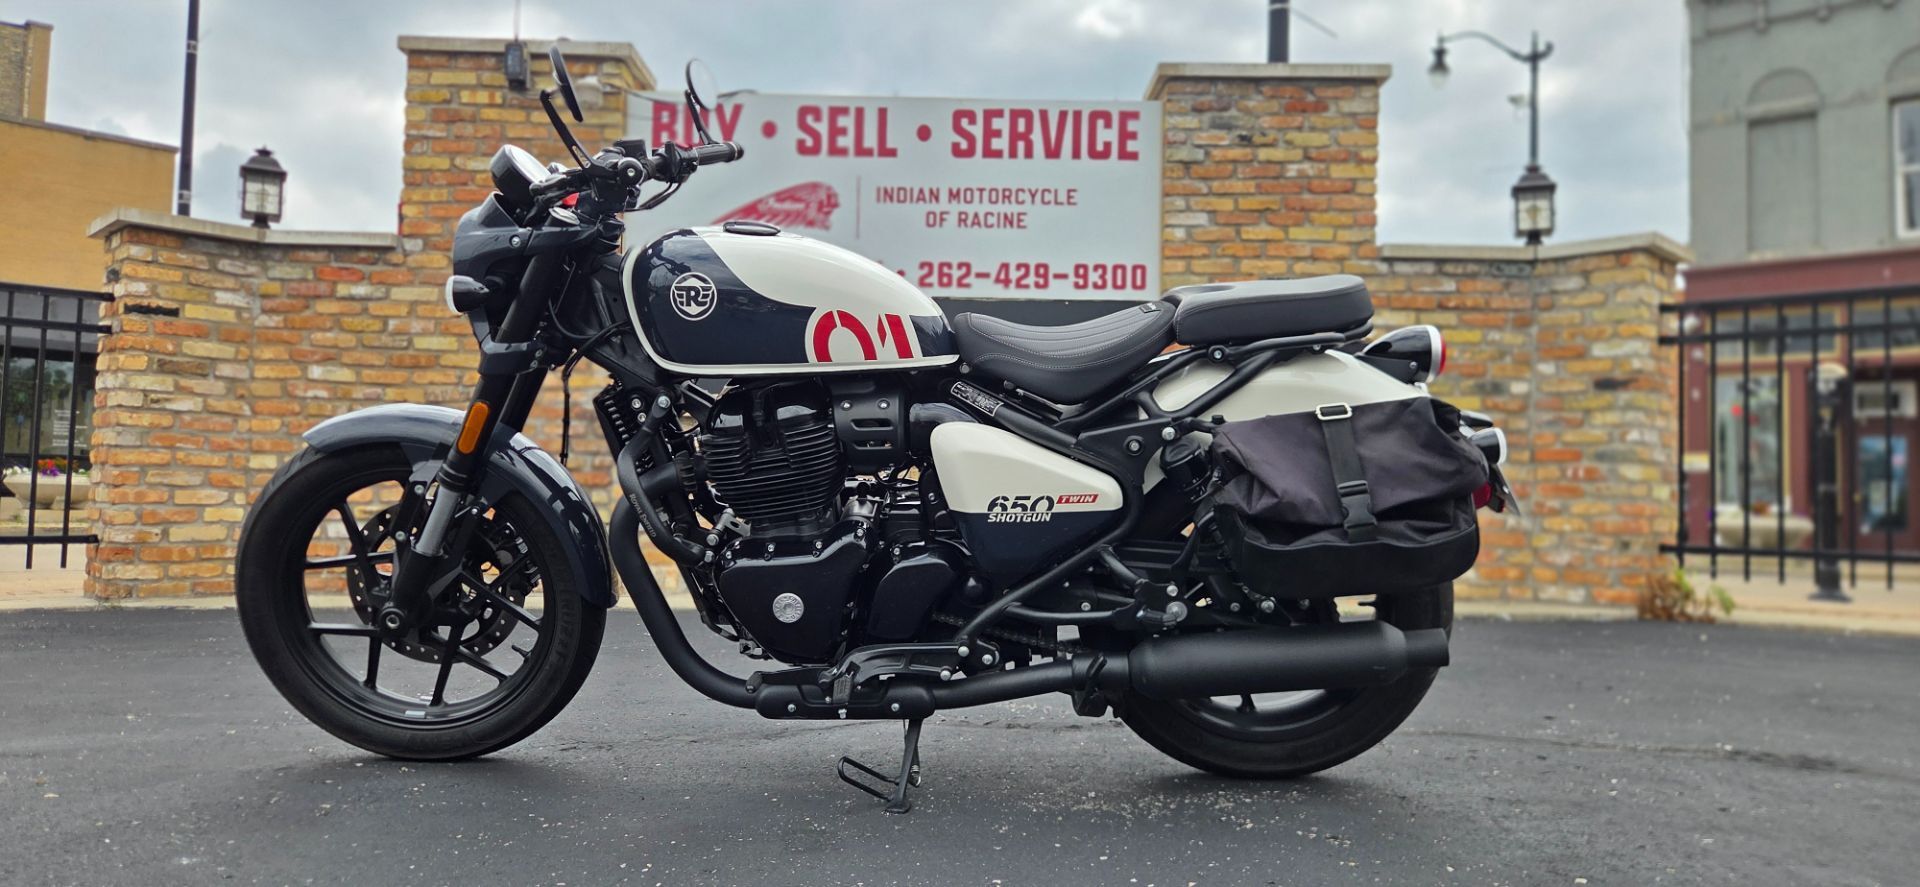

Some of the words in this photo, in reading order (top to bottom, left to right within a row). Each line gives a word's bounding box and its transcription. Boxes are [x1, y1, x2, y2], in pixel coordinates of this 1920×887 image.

[796, 105, 898, 158] SELL
[951, 108, 1141, 161] SERVICE
[876, 186, 940, 204] INDIAN
[947, 187, 1078, 206] MOTORCYCLE
[925, 211, 950, 228] OF
[957, 212, 1028, 229] RACINE
[917, 261, 1147, 291] 262-429-9300
[987, 495, 1055, 512] 650
[1060, 495, 1094, 503] TWIN
[987, 512, 1052, 523] SHOTGUN
